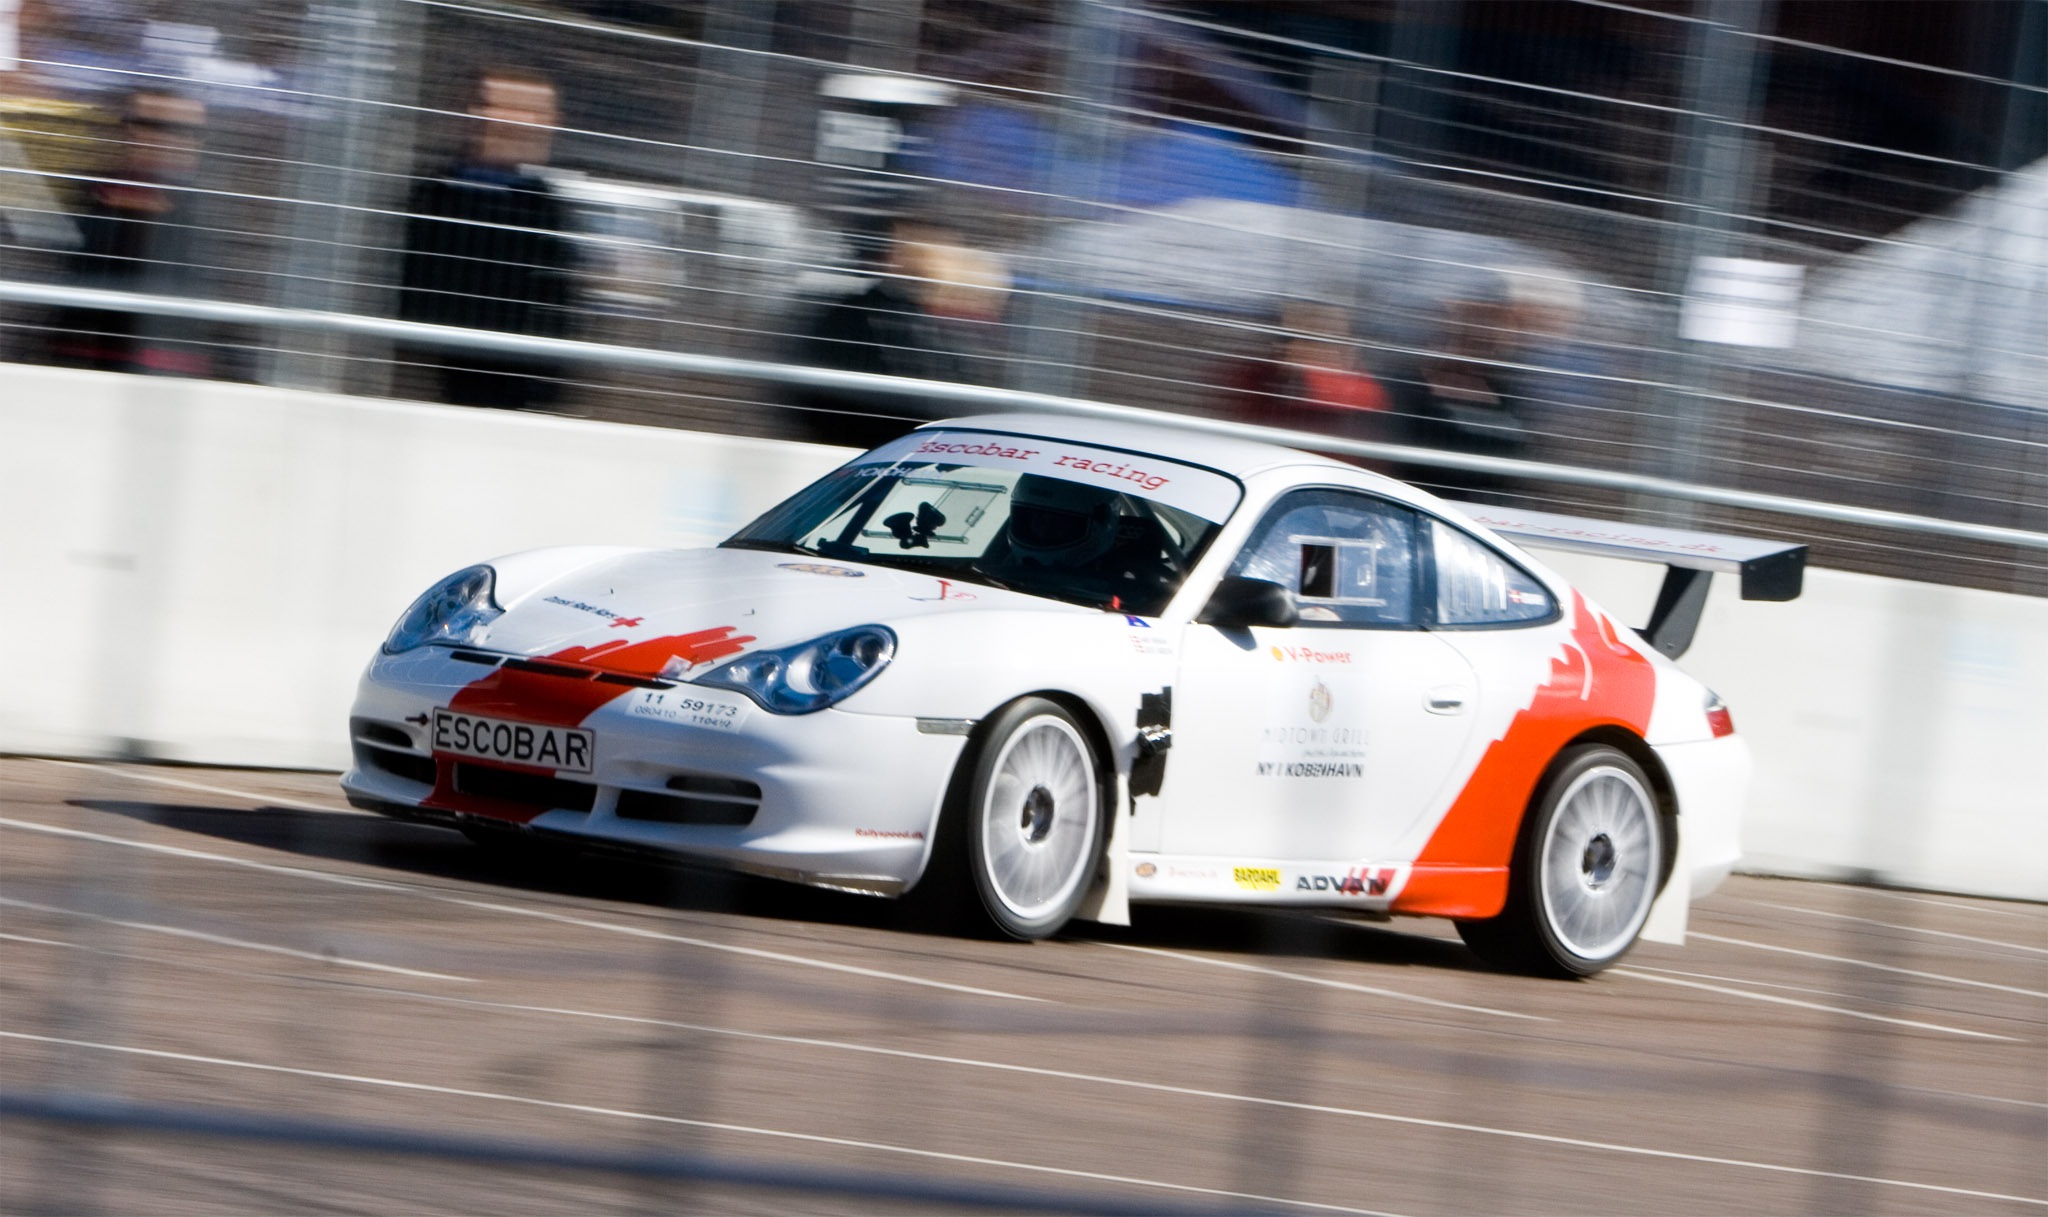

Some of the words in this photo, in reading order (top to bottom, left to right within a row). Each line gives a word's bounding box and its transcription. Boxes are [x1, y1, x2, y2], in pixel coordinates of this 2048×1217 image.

[915, 441, 1040, 461] Escobar
[1053, 453, 1170, 491] racing
[1472, 516, 1722, 552] bar-racing.dk
[1284, 646, 1352, 663] V-Power
[645, 692, 665, 704] 11
[680, 699, 738, 717] 59173
[436, 714, 589, 768] ESCOBAR
[1256, 761, 1274, 776] NY
[1296, 875, 1387, 897] ADVAN
